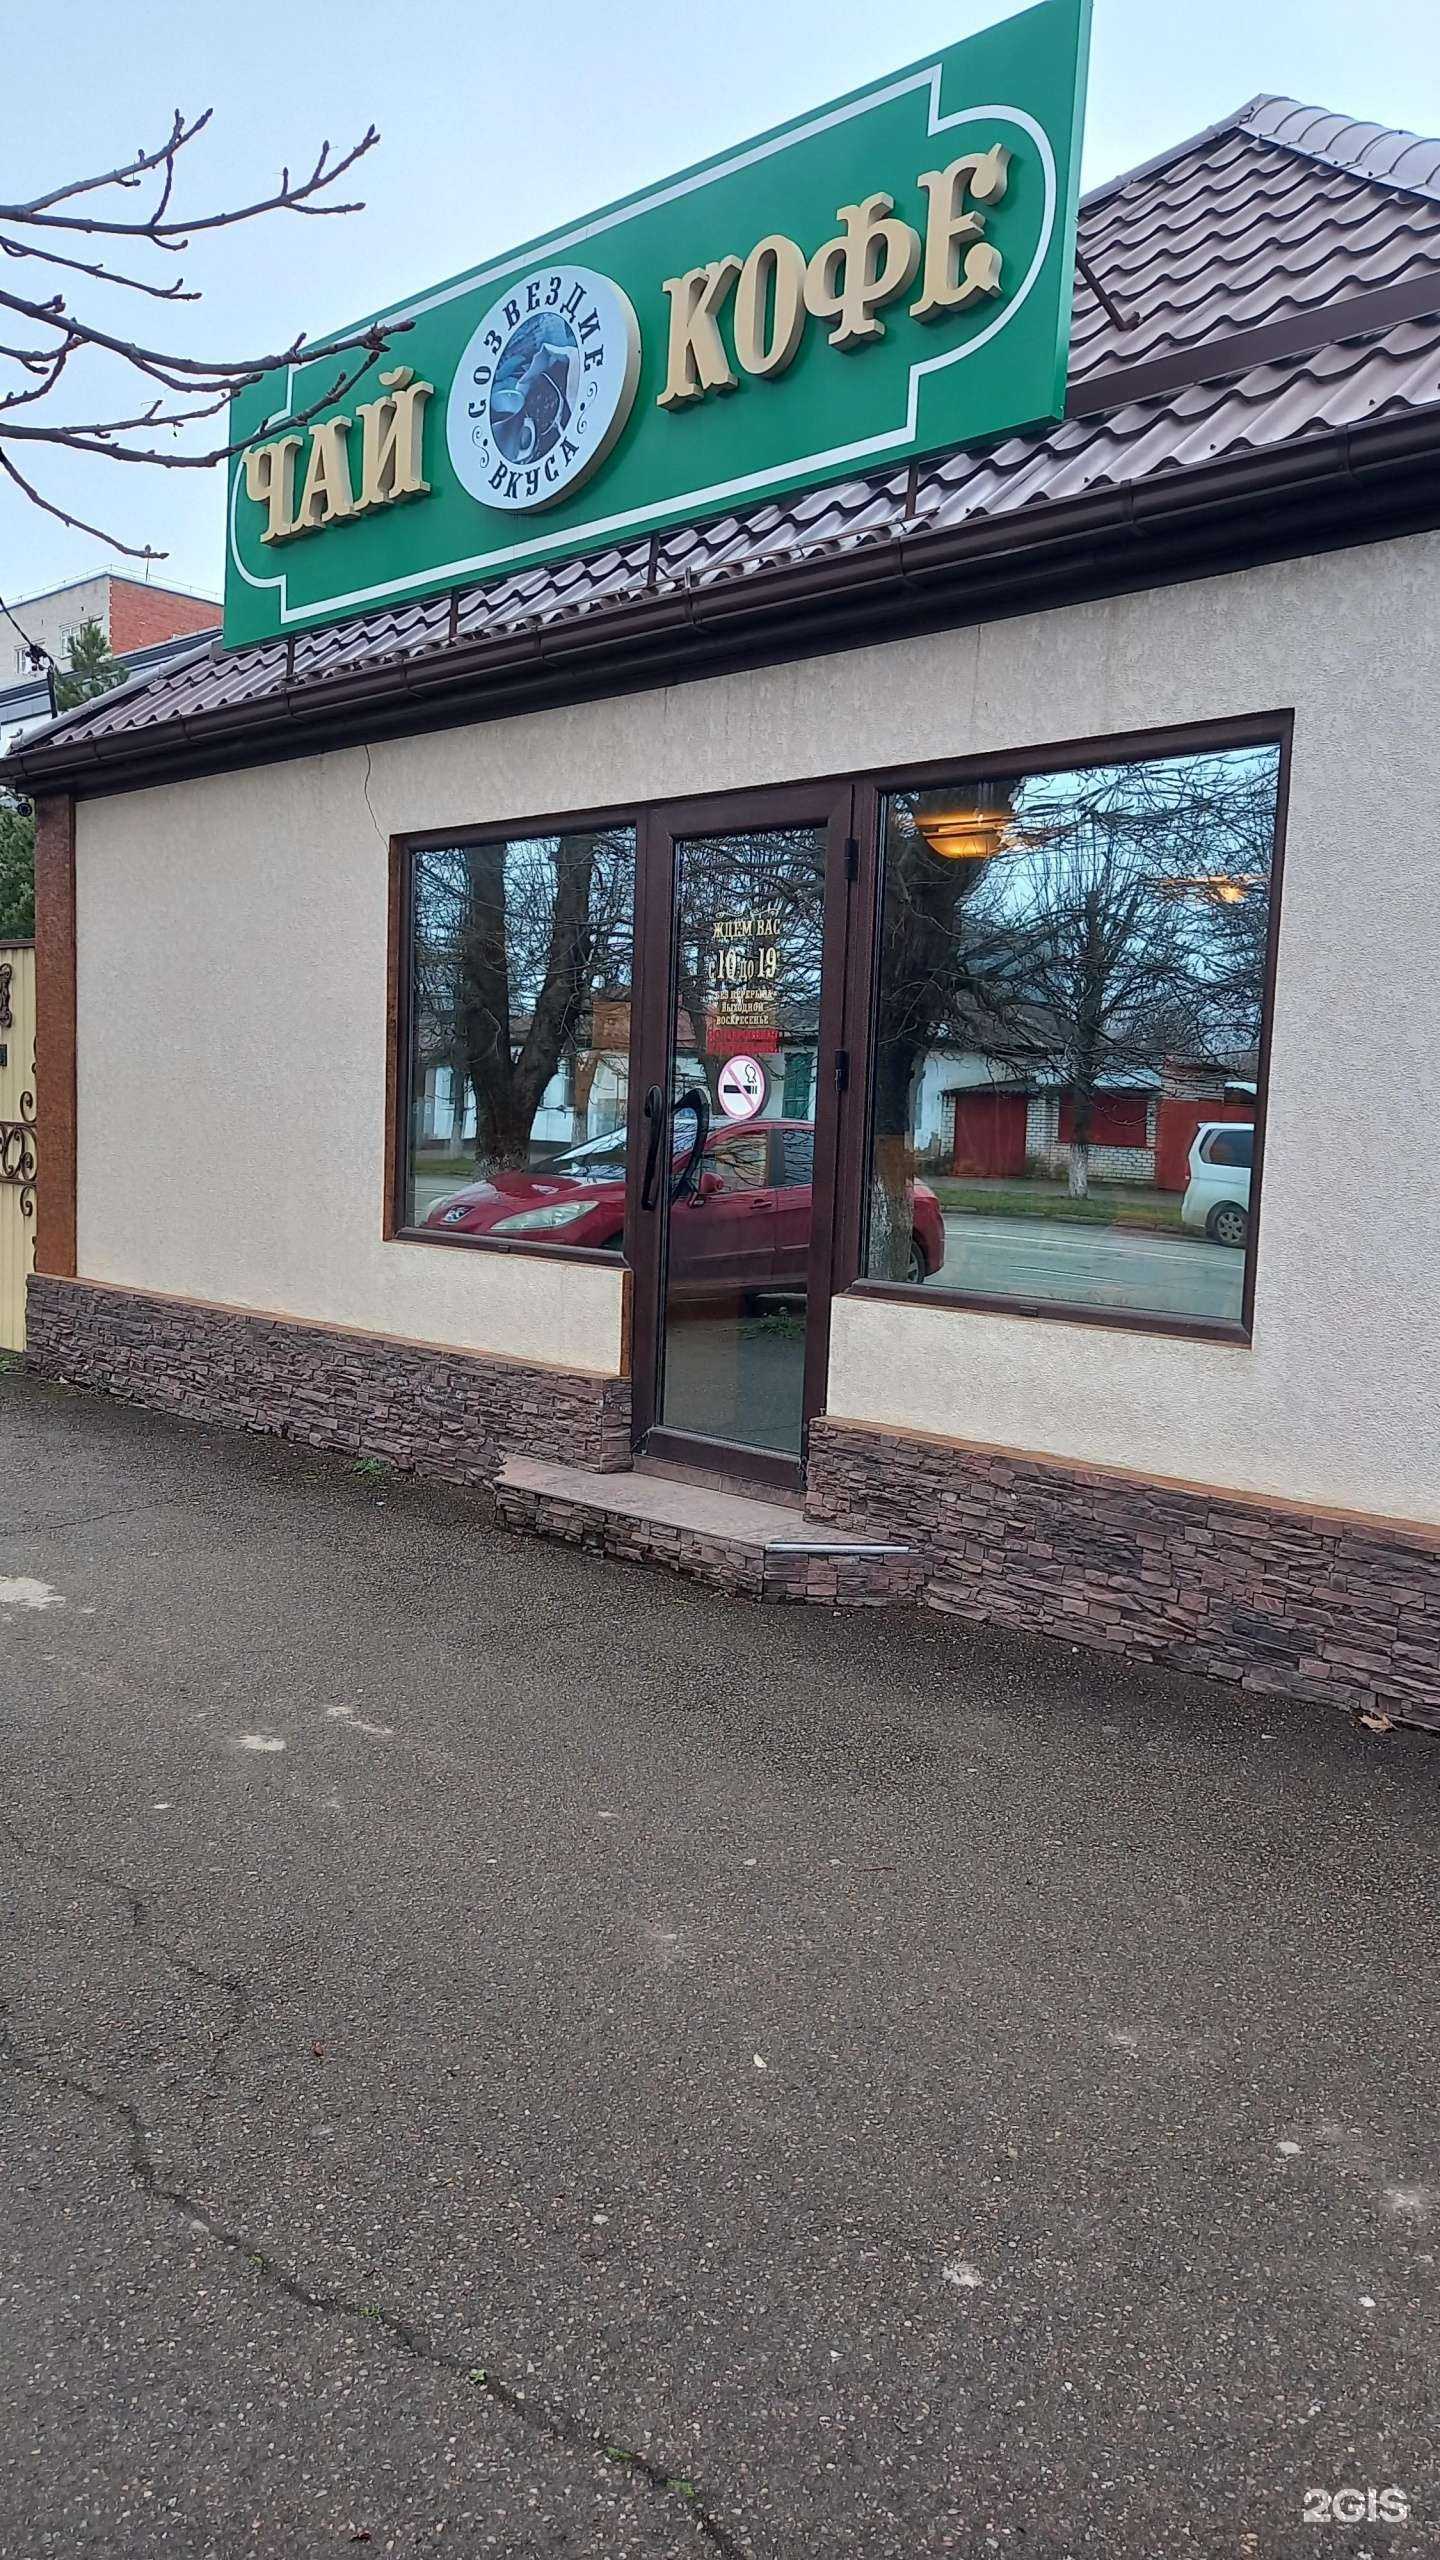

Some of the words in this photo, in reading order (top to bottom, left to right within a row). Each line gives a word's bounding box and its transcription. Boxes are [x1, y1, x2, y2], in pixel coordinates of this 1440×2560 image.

[656, 143, 1013, 411] КОФЕ
[468, 276, 604, 419] СОЗВЕЗДИЕ
[242, 366, 435, 546] ЧАЙ
[488, 436, 580, 499] ВКУСА
[712, 920, 753, 940] ЖДЕМ
[756, 918, 781, 936] ВАС
[717, 949, 737, 980] 10
[757, 947, 777, 978] 19
[716, 1015, 769, 1025] ВОСКРЕСЕНЬЕ
